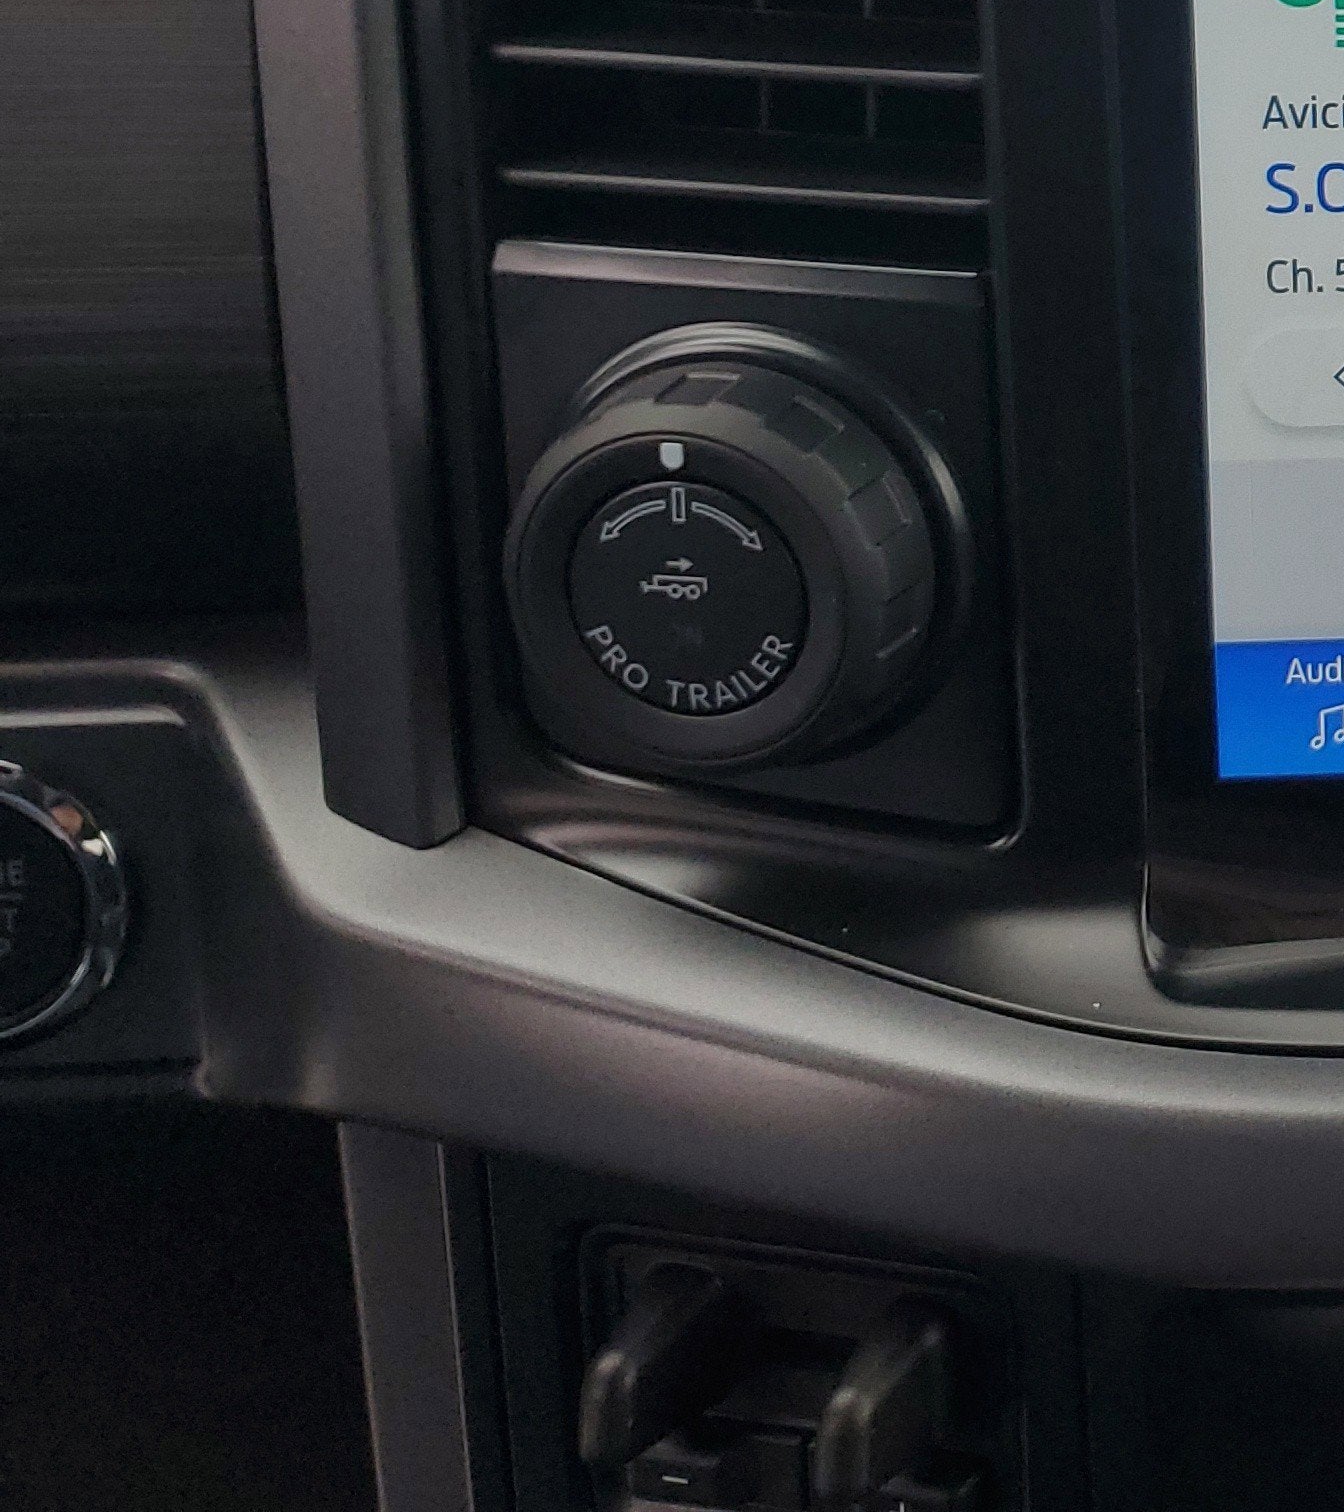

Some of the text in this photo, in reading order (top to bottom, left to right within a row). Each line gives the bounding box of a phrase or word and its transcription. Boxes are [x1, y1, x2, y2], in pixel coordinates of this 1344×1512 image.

[1265, 258, 1325, 294] Ch.
[585, 625, 793, 710] PRO TRAILER
